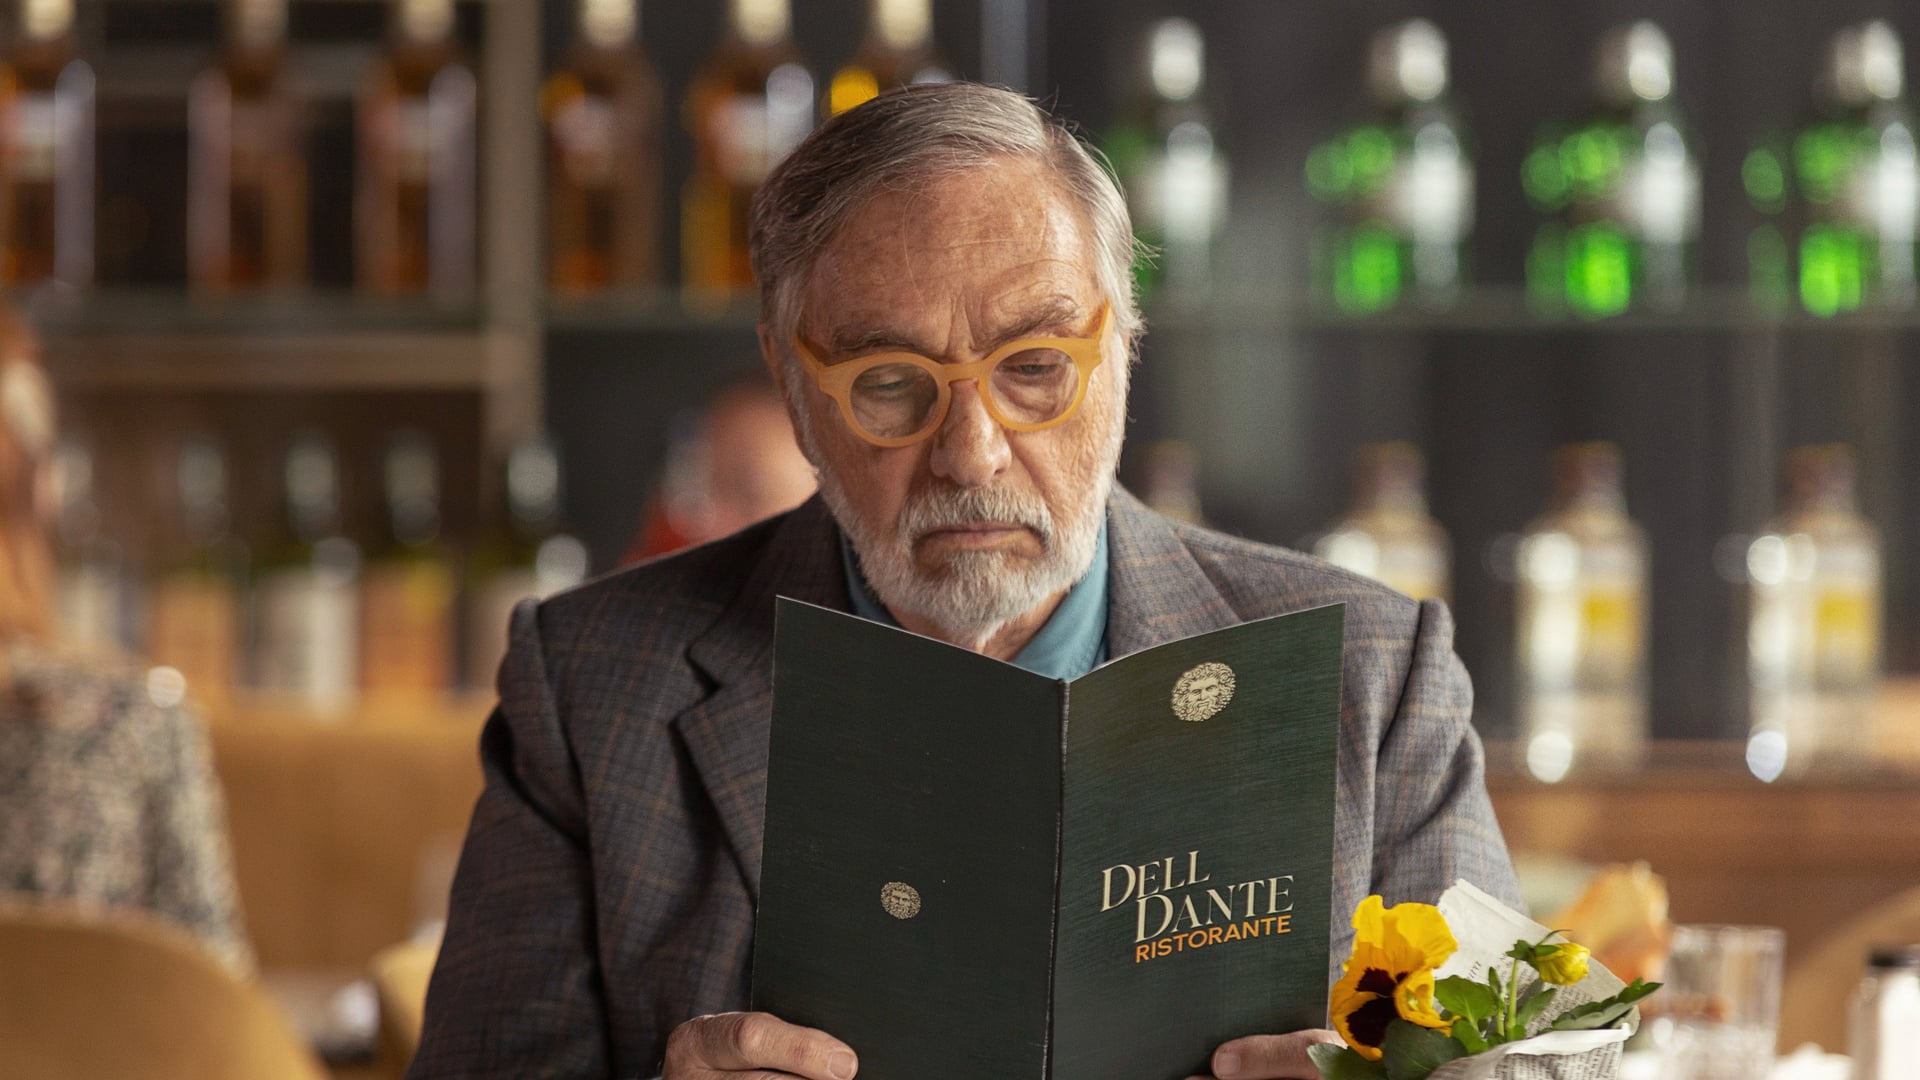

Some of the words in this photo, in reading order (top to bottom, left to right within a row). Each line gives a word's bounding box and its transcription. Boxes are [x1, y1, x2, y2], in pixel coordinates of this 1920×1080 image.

[1100, 850, 1210, 912] DELL
[1134, 875, 1294, 943] DANTE
[1135, 915, 1292, 963] RISTORANTE
